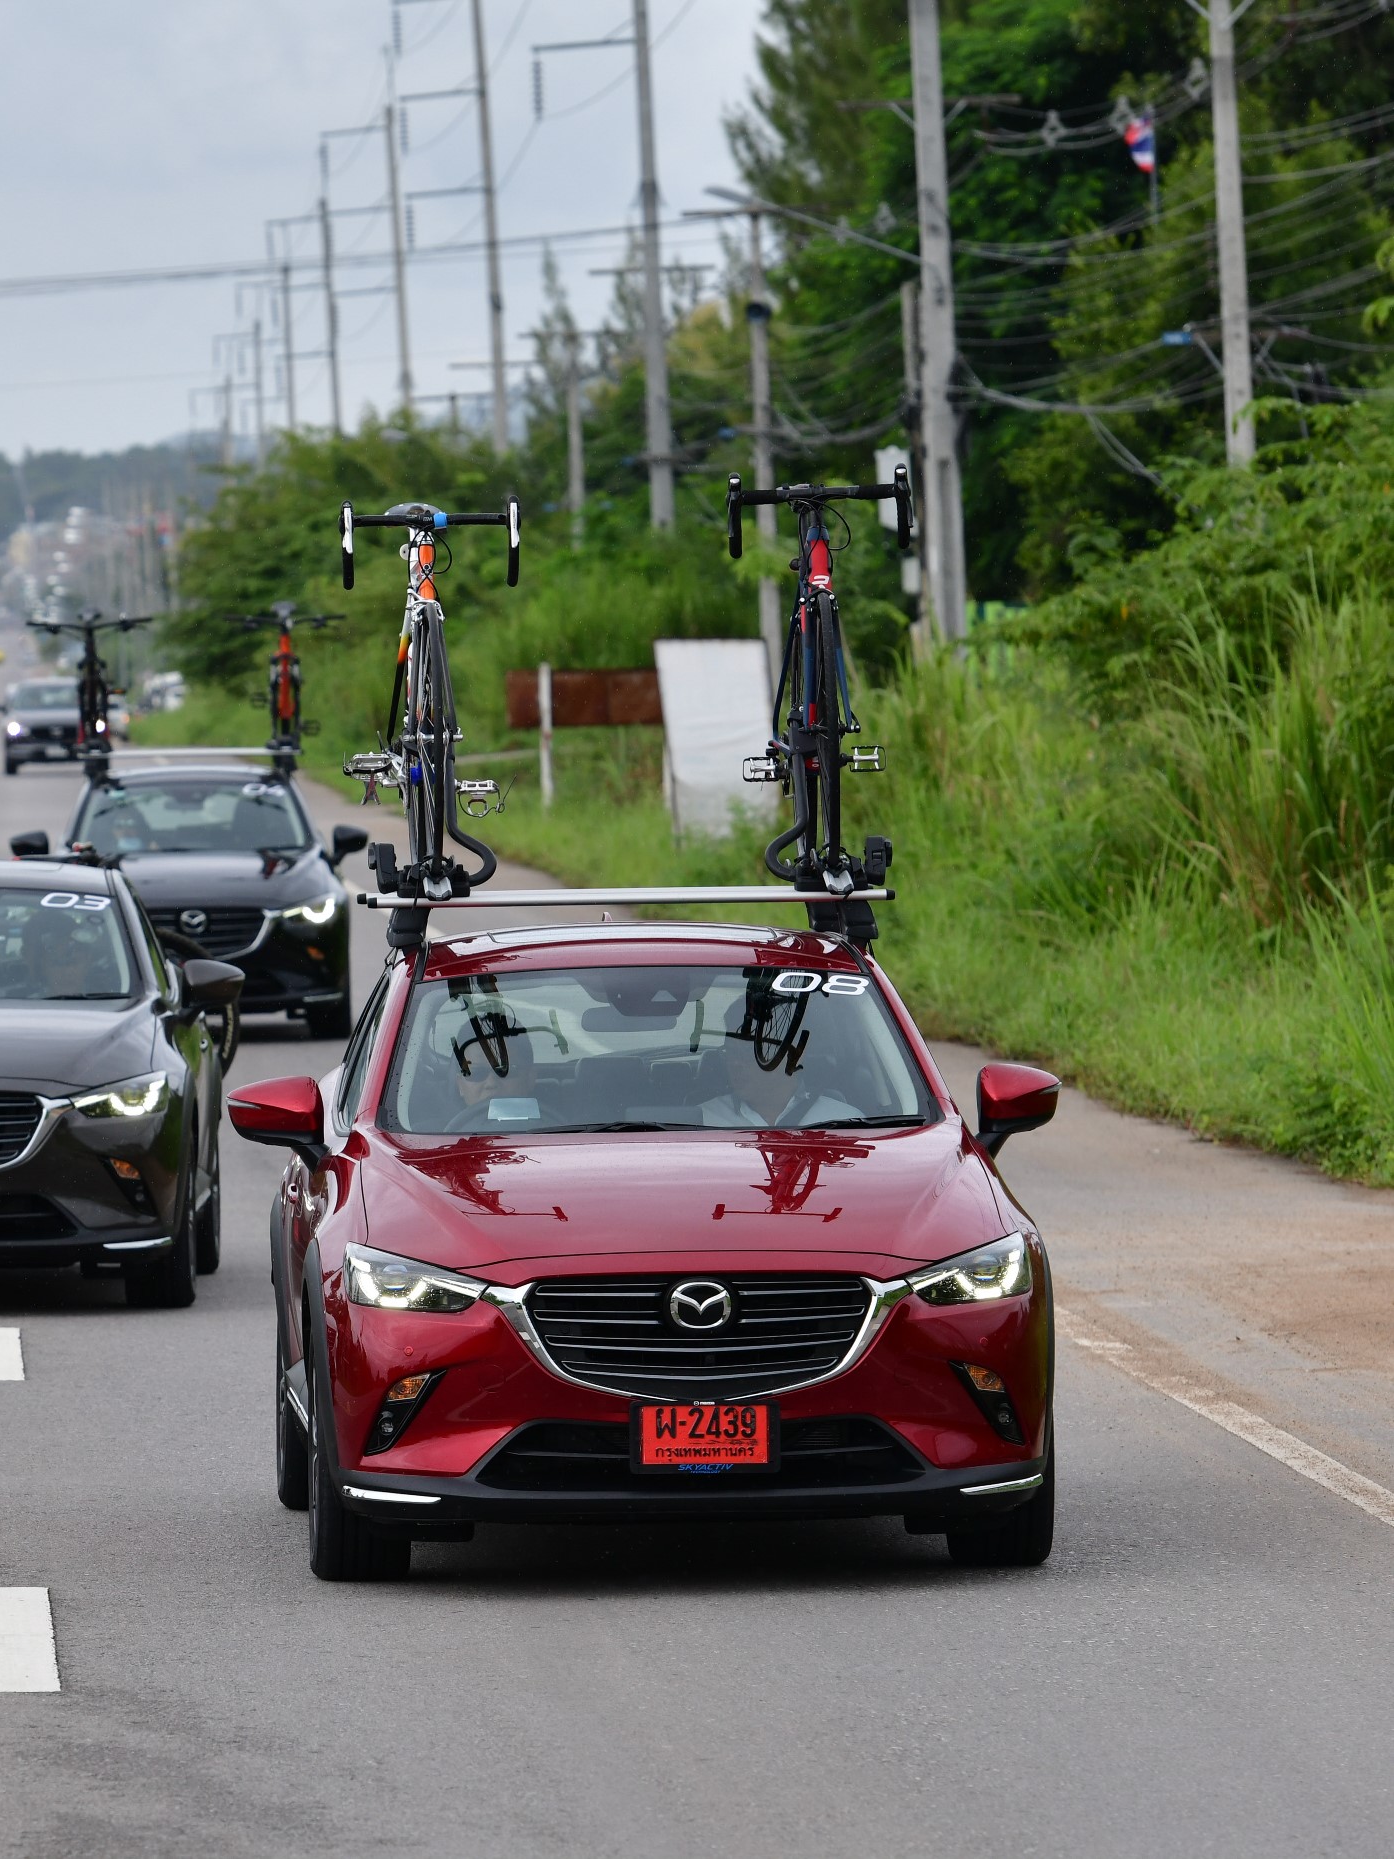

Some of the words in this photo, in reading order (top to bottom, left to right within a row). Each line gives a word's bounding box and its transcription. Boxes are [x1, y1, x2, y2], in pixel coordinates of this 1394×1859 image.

[40, 892, 111, 911] 03
[771, 972, 870, 996] 08
[655, 1446, 755, 1461] กรุงเทพมหานคร
[677, 1463, 734, 1471] SKYACTIV
